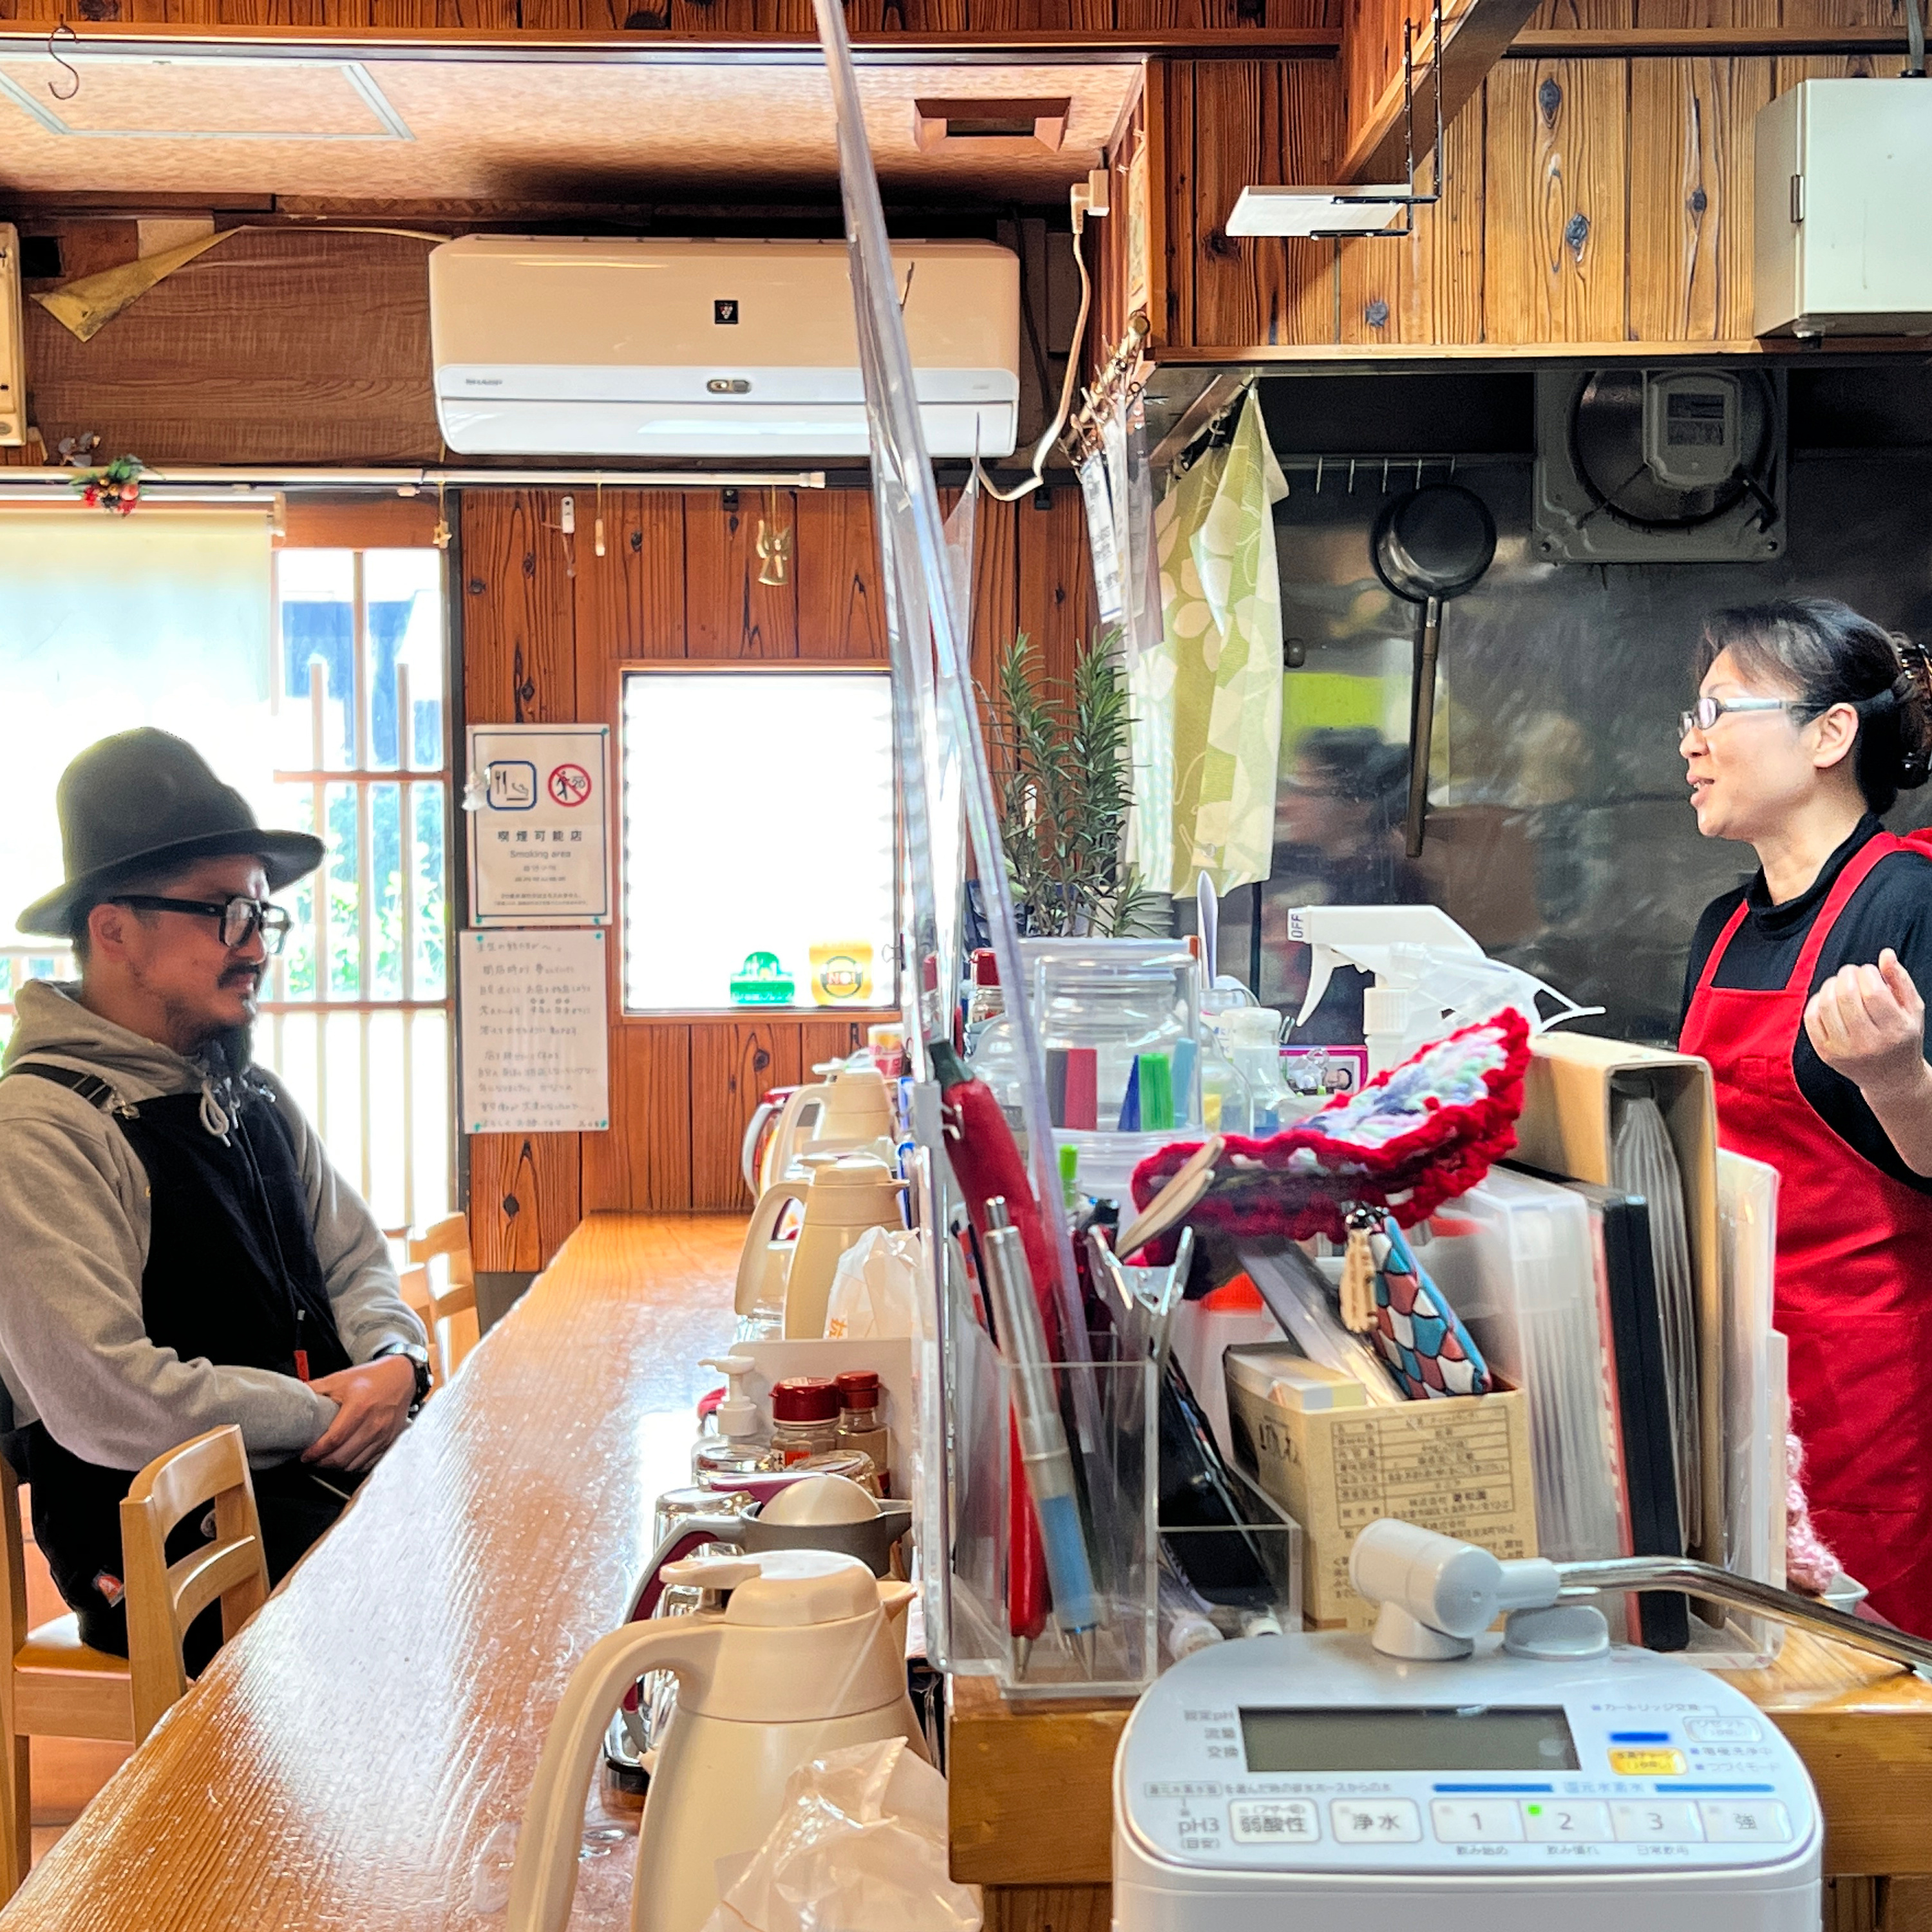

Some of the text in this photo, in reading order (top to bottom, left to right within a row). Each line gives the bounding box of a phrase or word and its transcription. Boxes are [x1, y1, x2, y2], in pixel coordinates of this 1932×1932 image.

[498, 830, 582, 842] 喫煙可能店
[510, 849, 548, 860] Smoking
[1291, 913, 1303, 938] OFF
[1178, 1817, 1220, 1835] pH3
[1241, 1816, 1307, 1833] 弱酸性
[1352, 1814, 1400, 1831] 浄水
[1470, 1813, 1482, 1831] 1
[1557, 1813, 1575, 1830] 2
[1649, 1813, 1665, 1830] 3
